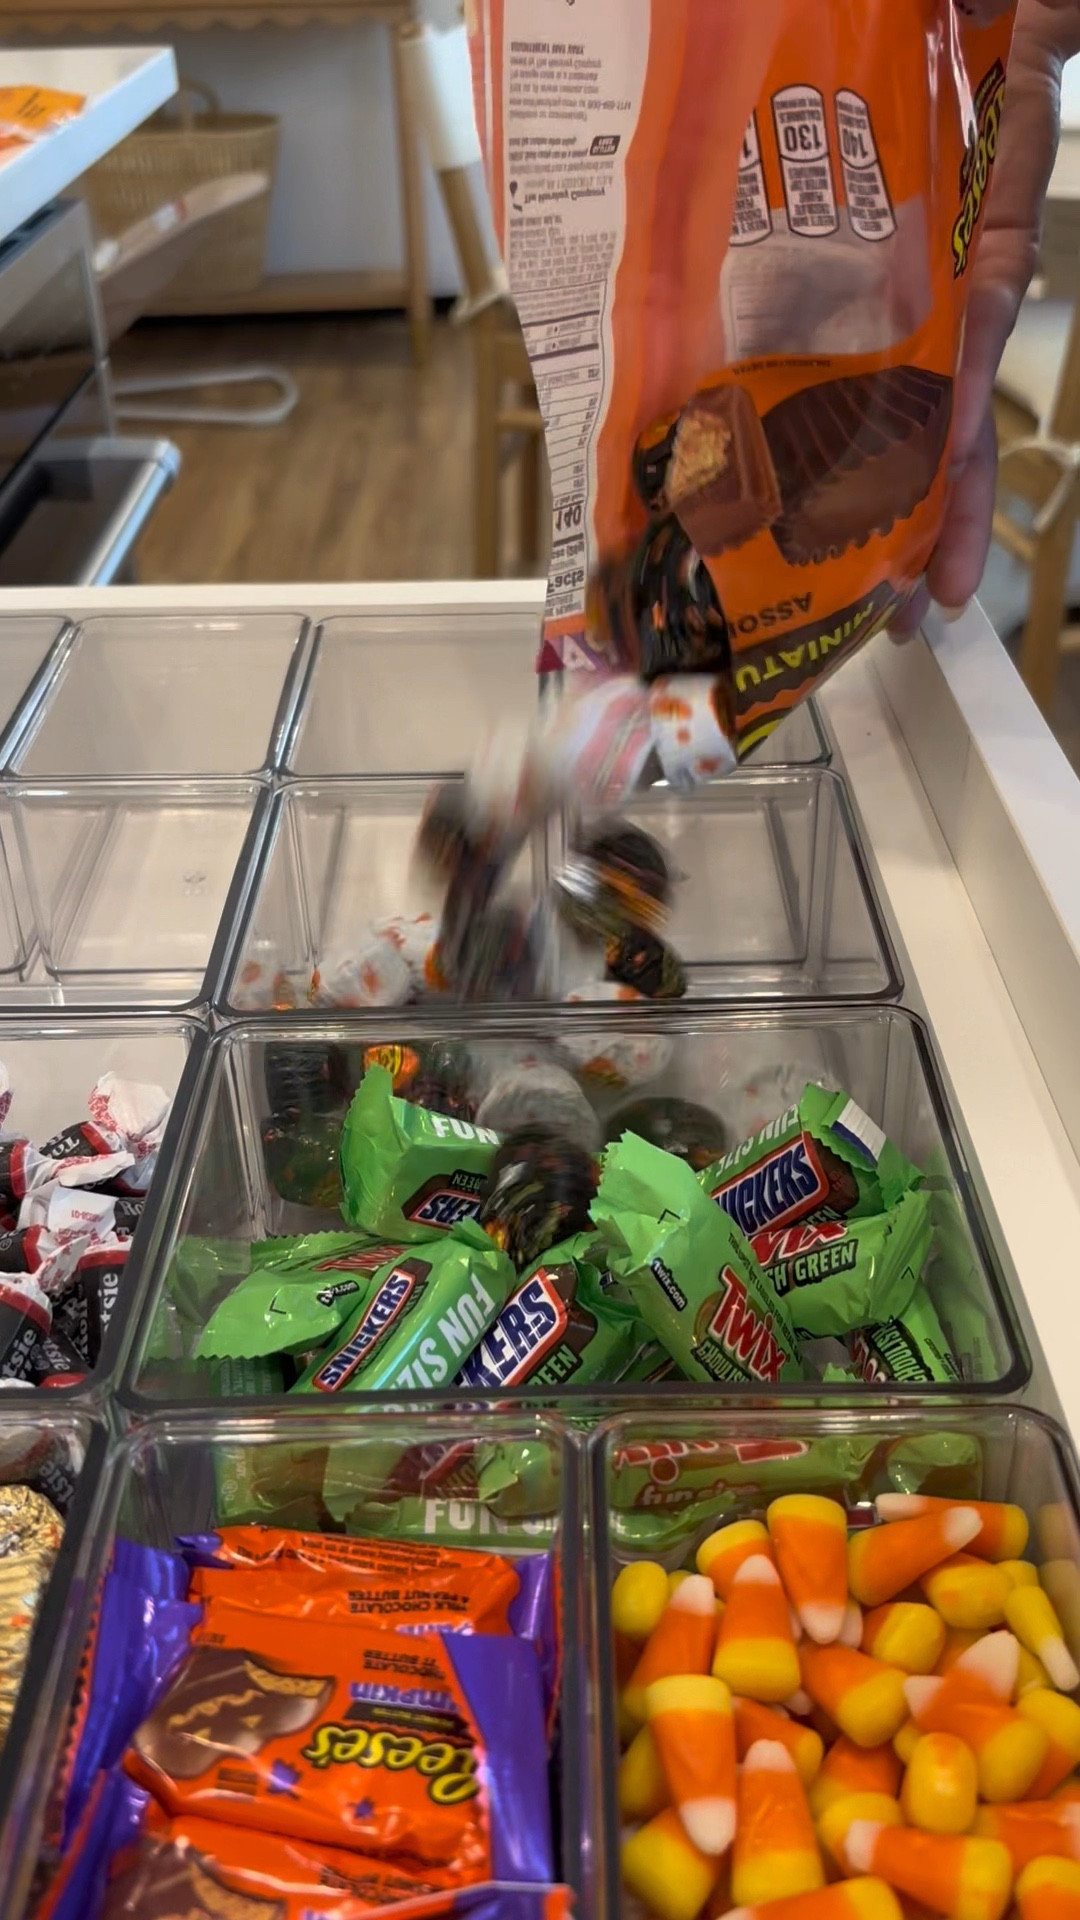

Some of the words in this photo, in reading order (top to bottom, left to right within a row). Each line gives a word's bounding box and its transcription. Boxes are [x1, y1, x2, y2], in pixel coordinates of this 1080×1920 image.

[784, 124, 822, 153] 130
[843, 128, 868, 159] 140
[735, 601, 876, 694] MINIATU
[431, 1112, 501, 1146] FUN
[793, 1243, 857, 1284] GREEN
[100, 1272, 119, 1332] tsie
[440, 1272, 496, 1358] FUN
[3, 1329, 38, 1378] tsie
[319, 1274, 411, 1388] SNICKERS
[460, 1278, 558, 1387] KERS
[389, 1337, 450, 1389] SIZ
[350, 1600, 431, 1615] CHOCOLATE
